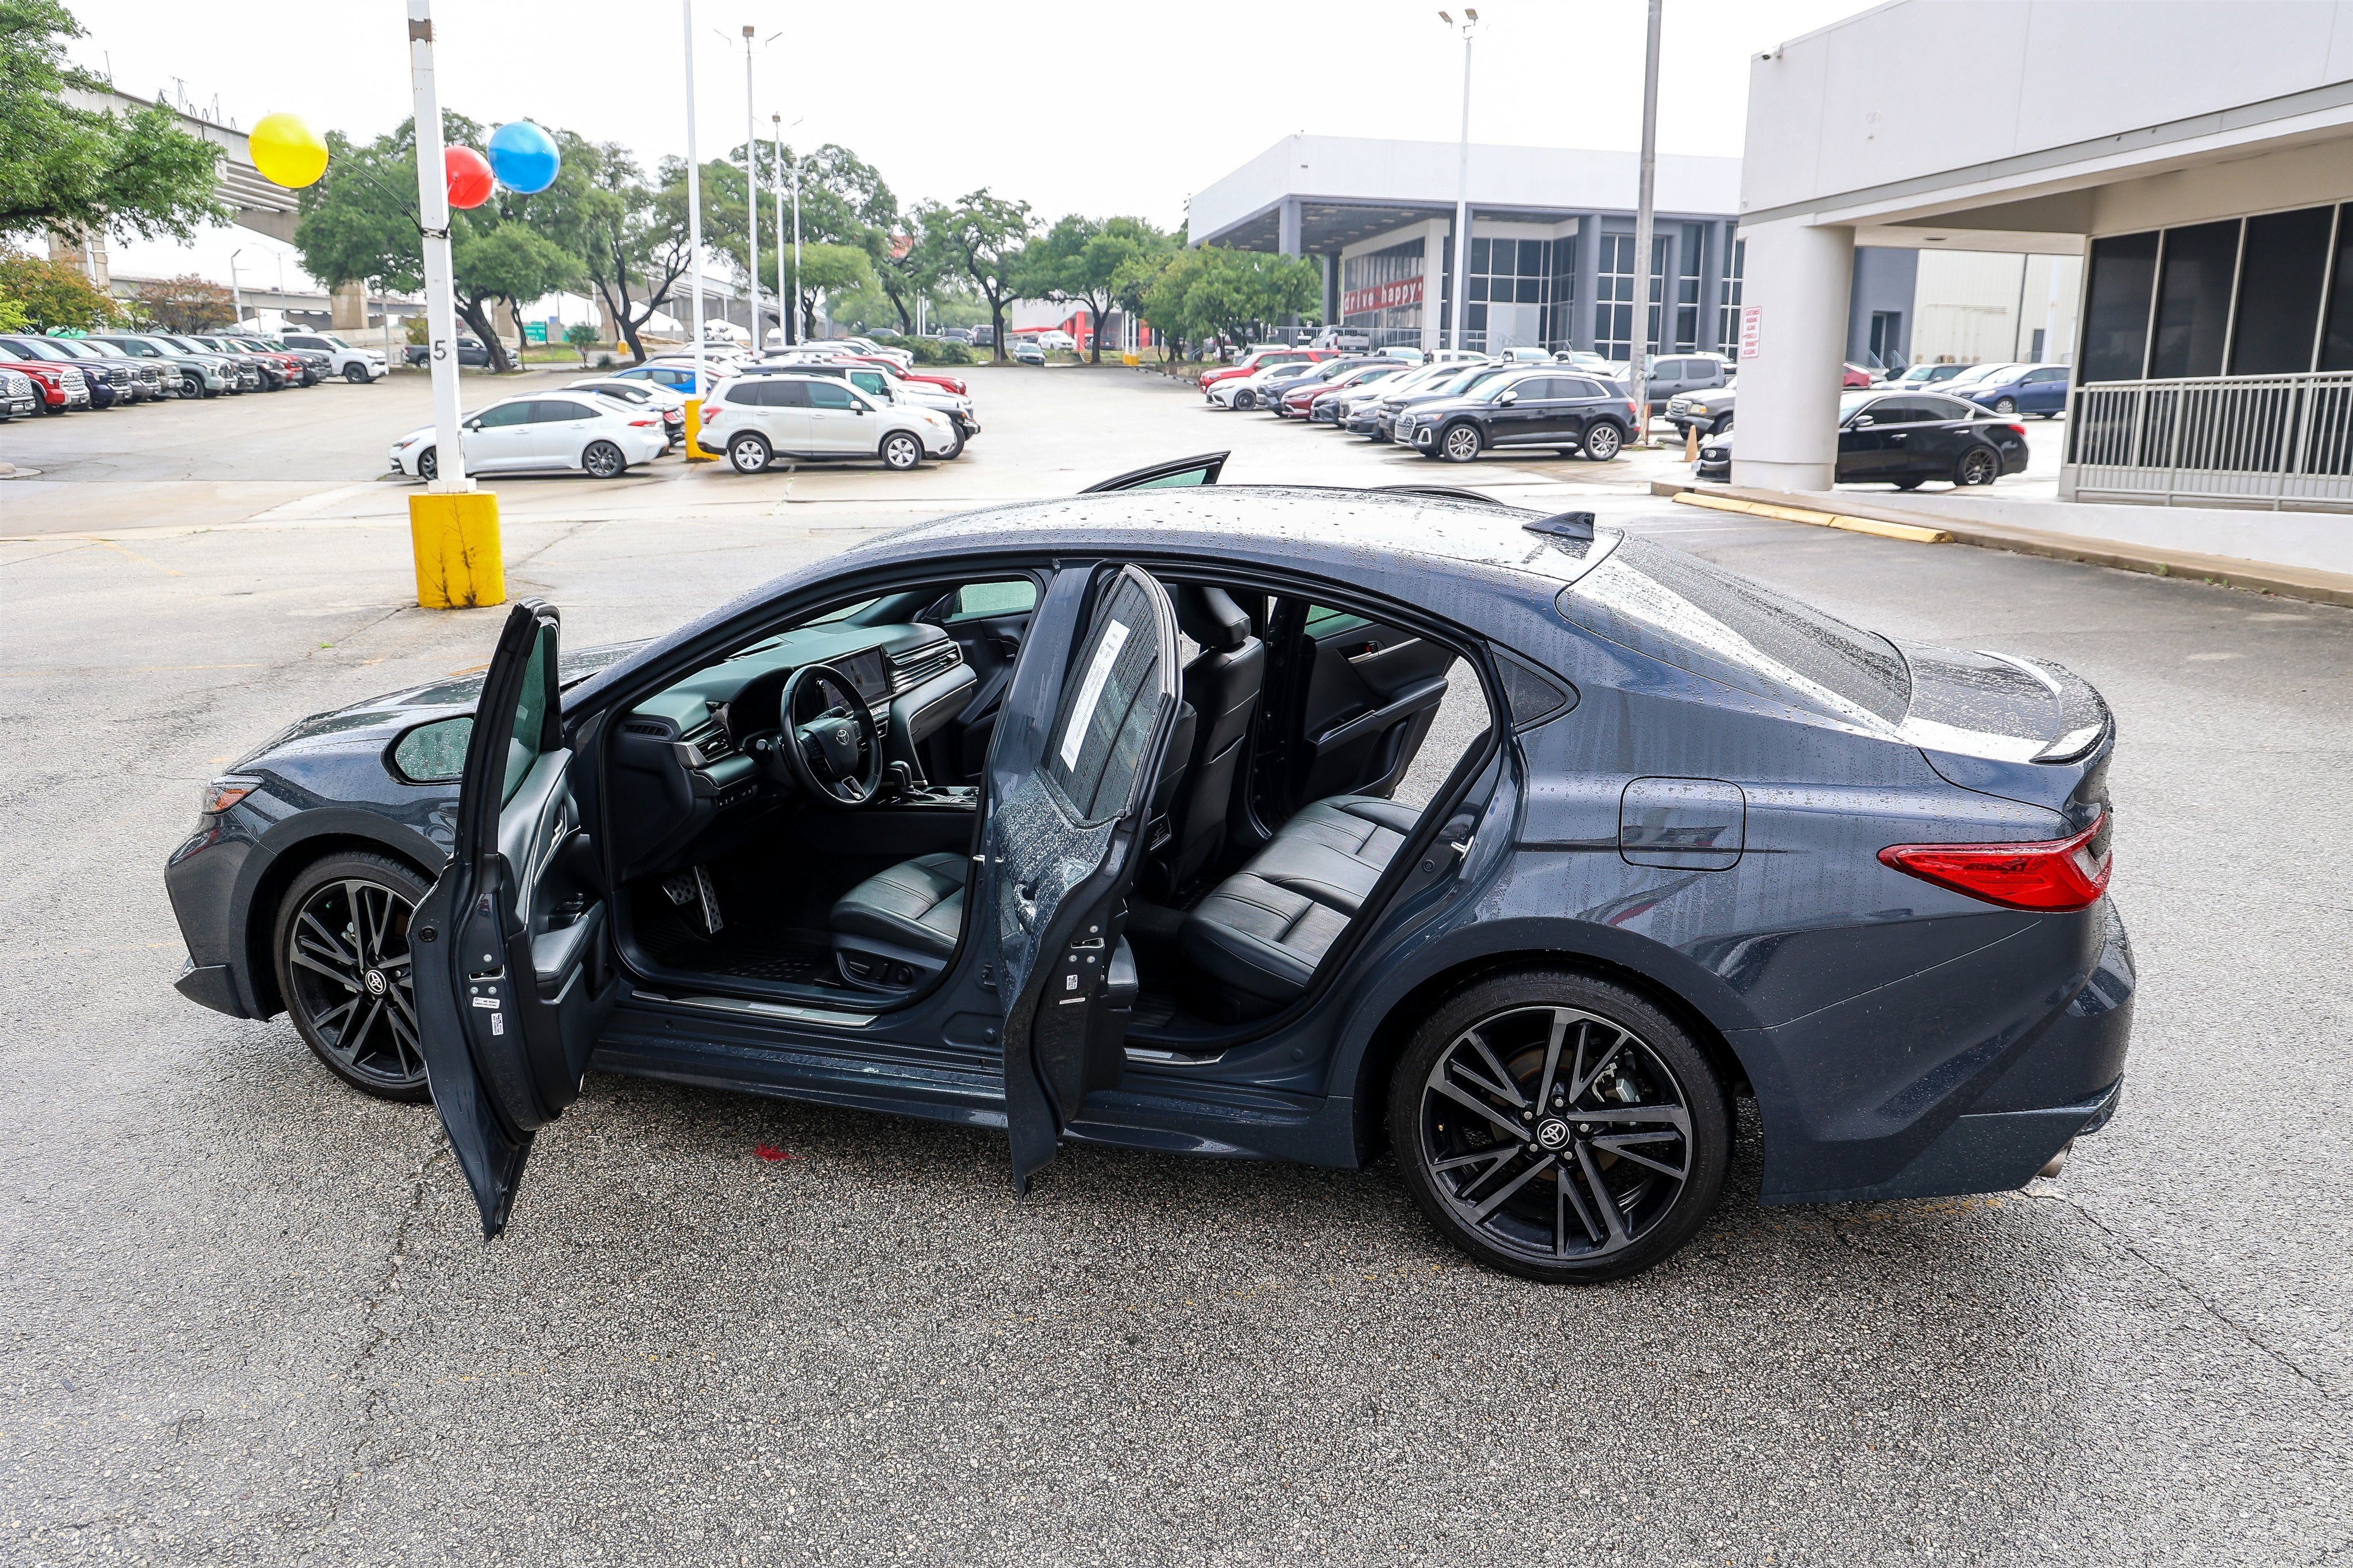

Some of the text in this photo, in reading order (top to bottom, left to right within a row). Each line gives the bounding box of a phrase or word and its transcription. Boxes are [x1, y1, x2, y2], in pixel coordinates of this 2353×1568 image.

[1344, 282, 1416, 310] drive happy
[433, 339, 446, 360] 5
